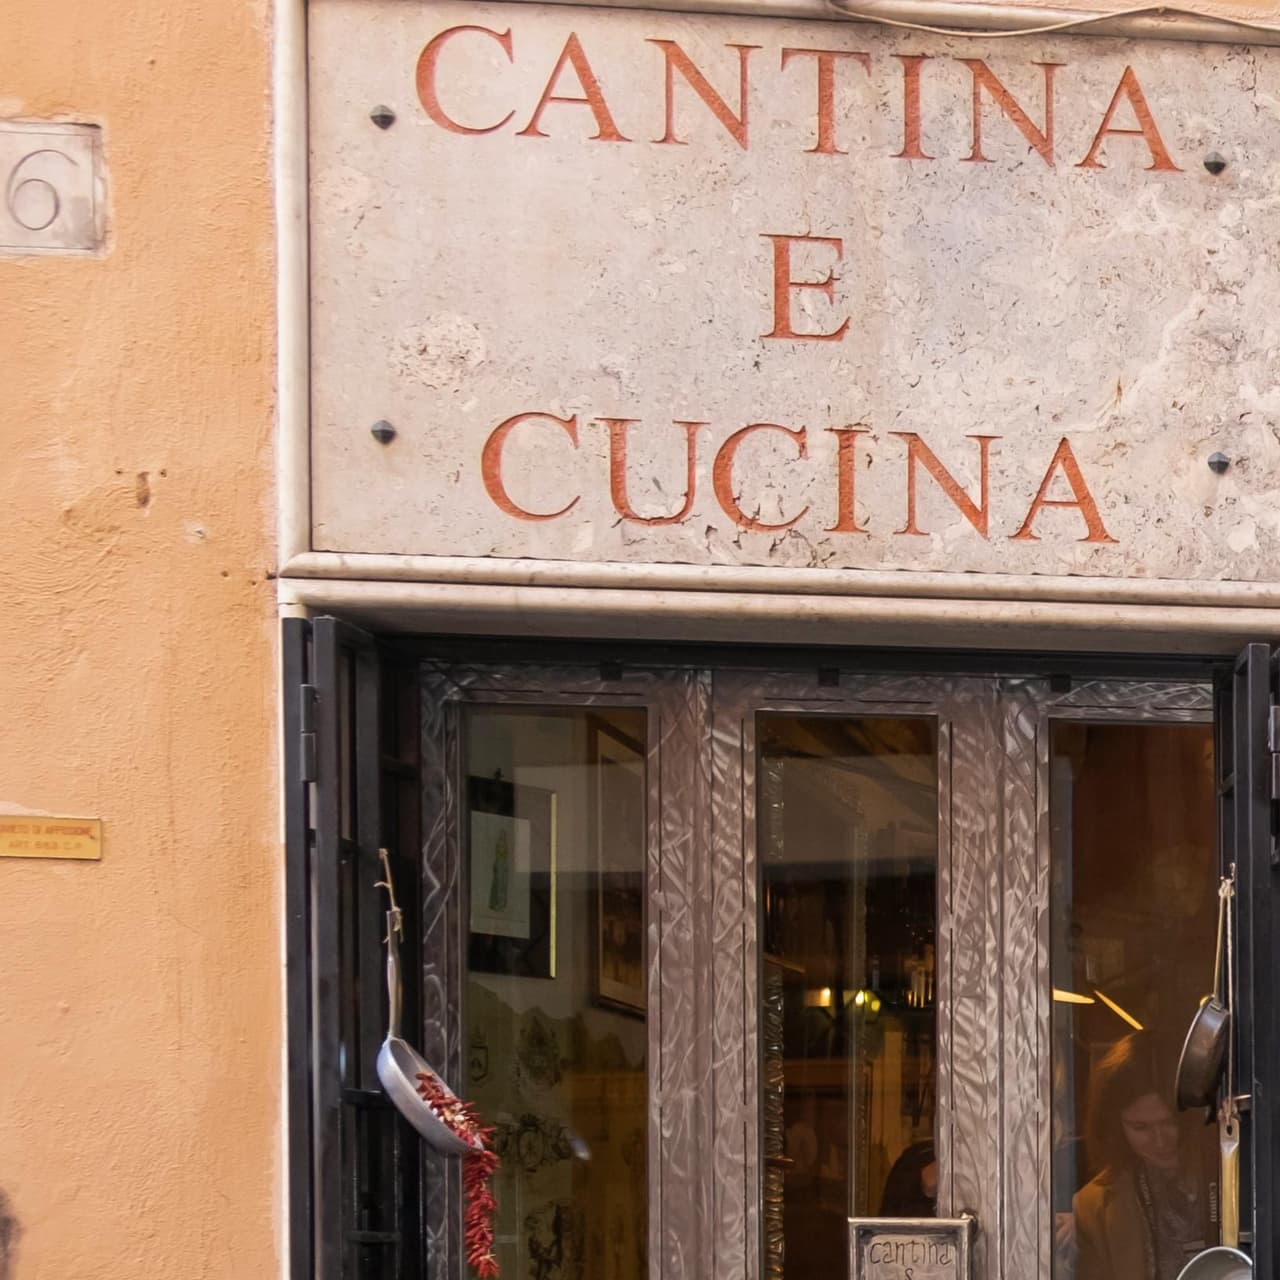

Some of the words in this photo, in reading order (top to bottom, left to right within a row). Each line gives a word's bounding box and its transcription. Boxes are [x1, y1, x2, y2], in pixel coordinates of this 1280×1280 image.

[415, 24, 1186, 174] CANTINA
[758, 231, 852, 343] E
[481, 411, 1121, 544] CUCINA
[868, 1237, 953, 1267] cantina
